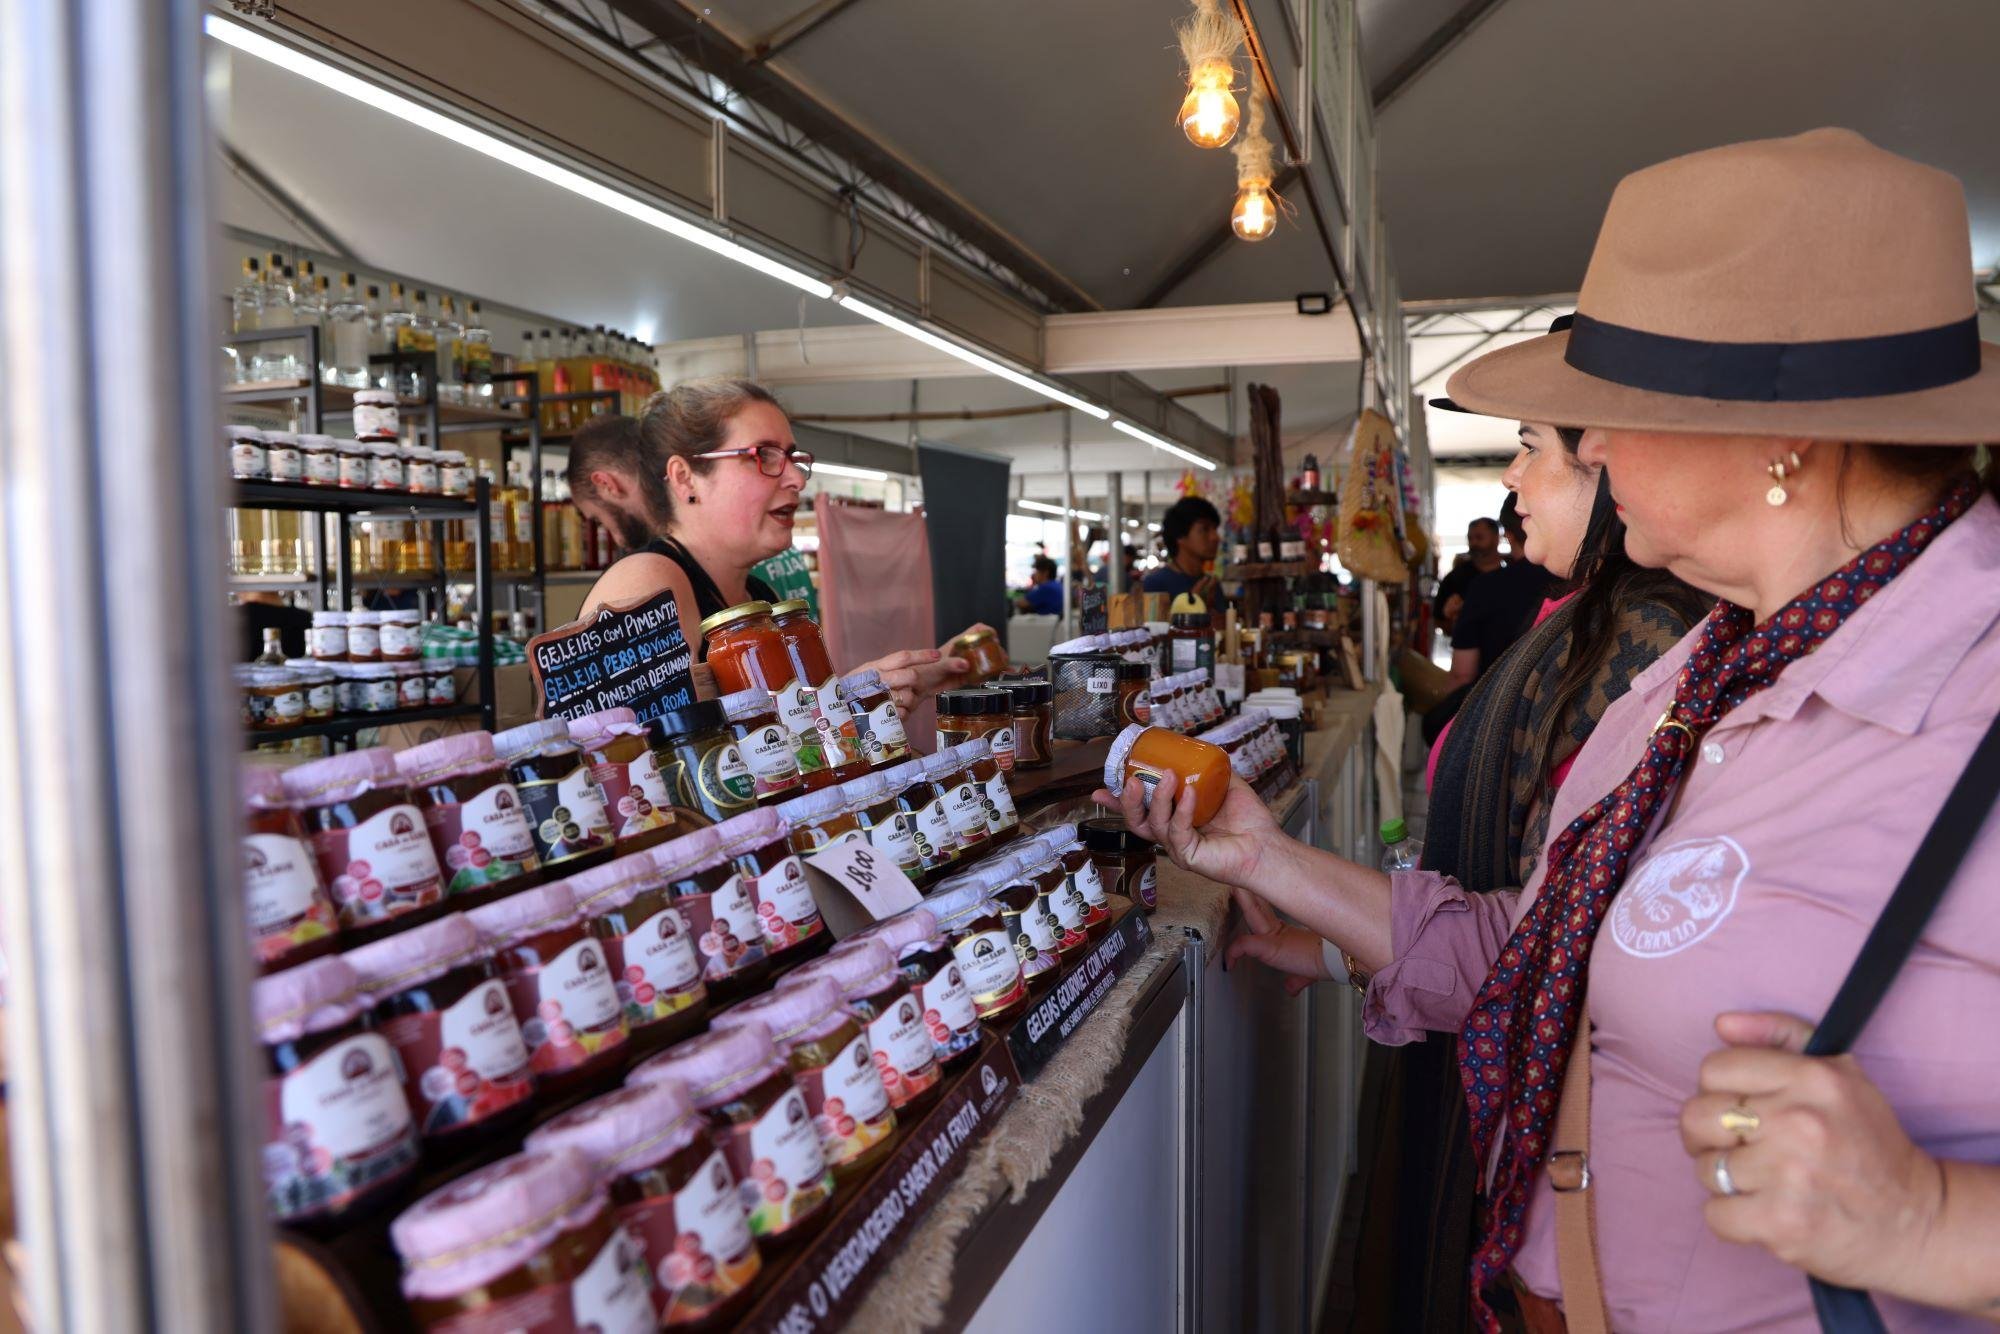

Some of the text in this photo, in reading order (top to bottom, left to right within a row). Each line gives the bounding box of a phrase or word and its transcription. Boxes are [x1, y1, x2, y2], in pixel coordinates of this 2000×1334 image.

[538, 600, 678, 672] GELEIAS COM PIMENTA
[544, 629, 684, 702] GELEIA PERA AO VINHO
[598, 675, 649, 711] PIMENTA
[648, 652, 691, 688] DEFUMADA
[1092, 681, 1108, 689] LIXO
[662, 687, 691, 713] ROXA
[788, 707, 804, 716] CASA
[755, 745, 771, 754] CASA
[952, 803, 967, 811] CASA
[887, 831, 902, 841] CASA
[845, 850, 878, 892] 18,00
[962, 957, 984, 971] CASA
[1026, 995, 1060, 1044] GELEIAS
[1057, 964, 1089, 1011] GOURMET
[1086, 951, 1103, 980] COM
[1099, 929, 1126, 967] PIMENTA
[1069, 1006, 1083, 1029] SABOR
[1081, 997, 1092, 1014] PARA
[808, 1101, 981, 1318] O VERDADEIRO SABOR DA FRUTA
